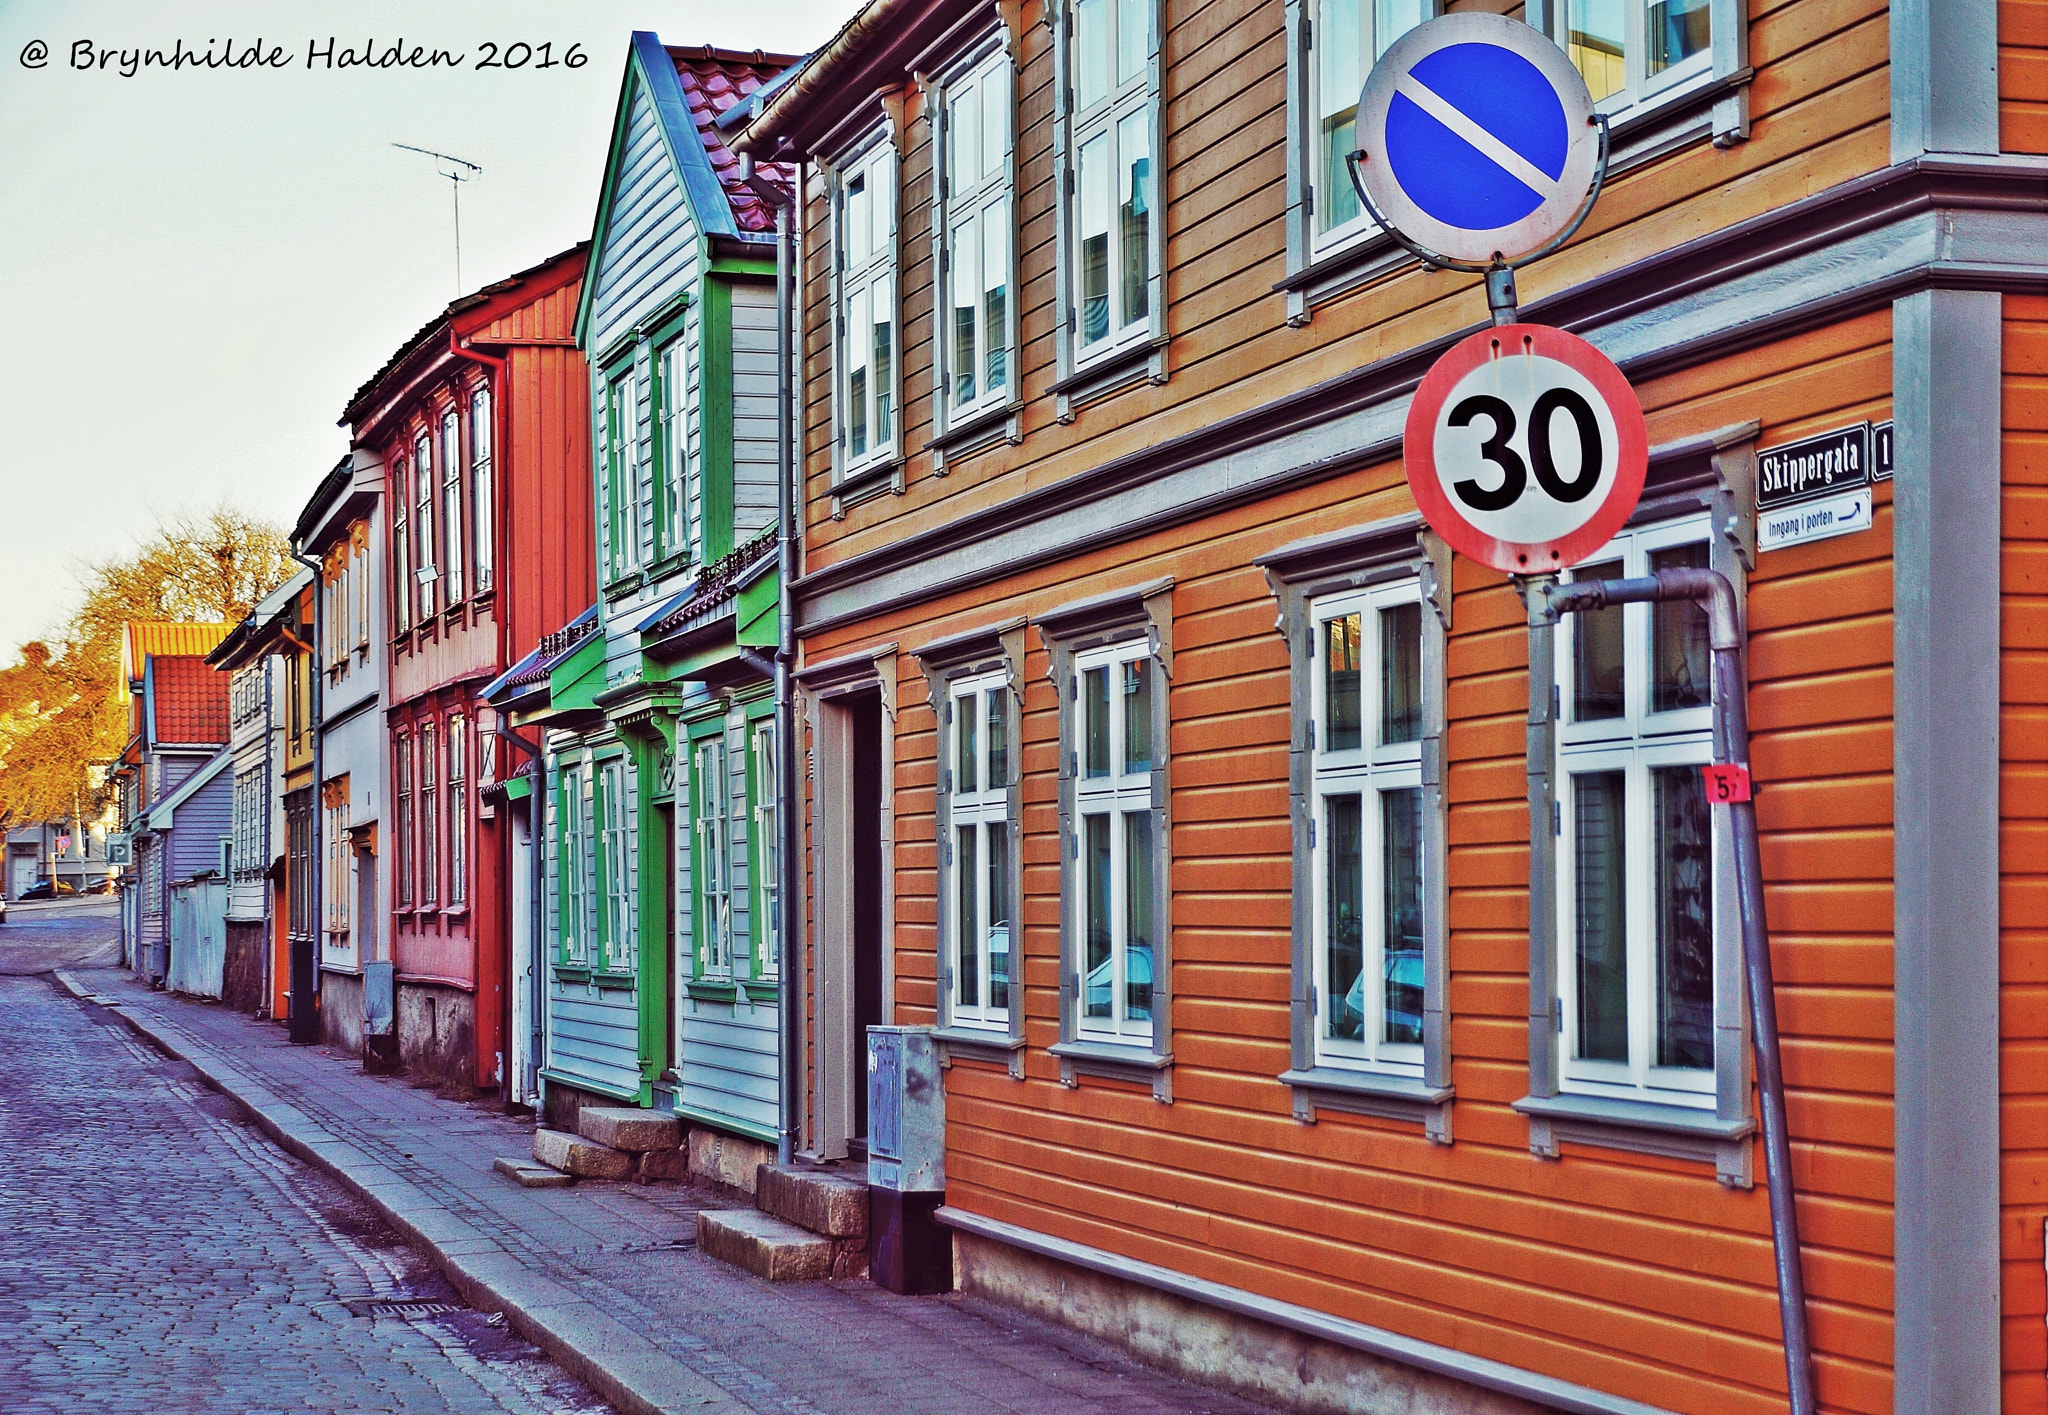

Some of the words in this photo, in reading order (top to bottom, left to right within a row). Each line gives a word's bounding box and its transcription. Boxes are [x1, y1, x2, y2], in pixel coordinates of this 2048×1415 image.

[1447, 387, 1603, 512] 30
[1763, 436, 1859, 493] Skippergata
[1768, 518, 1799, 539] Inngang
[1806, 509, 1833, 533] porten
